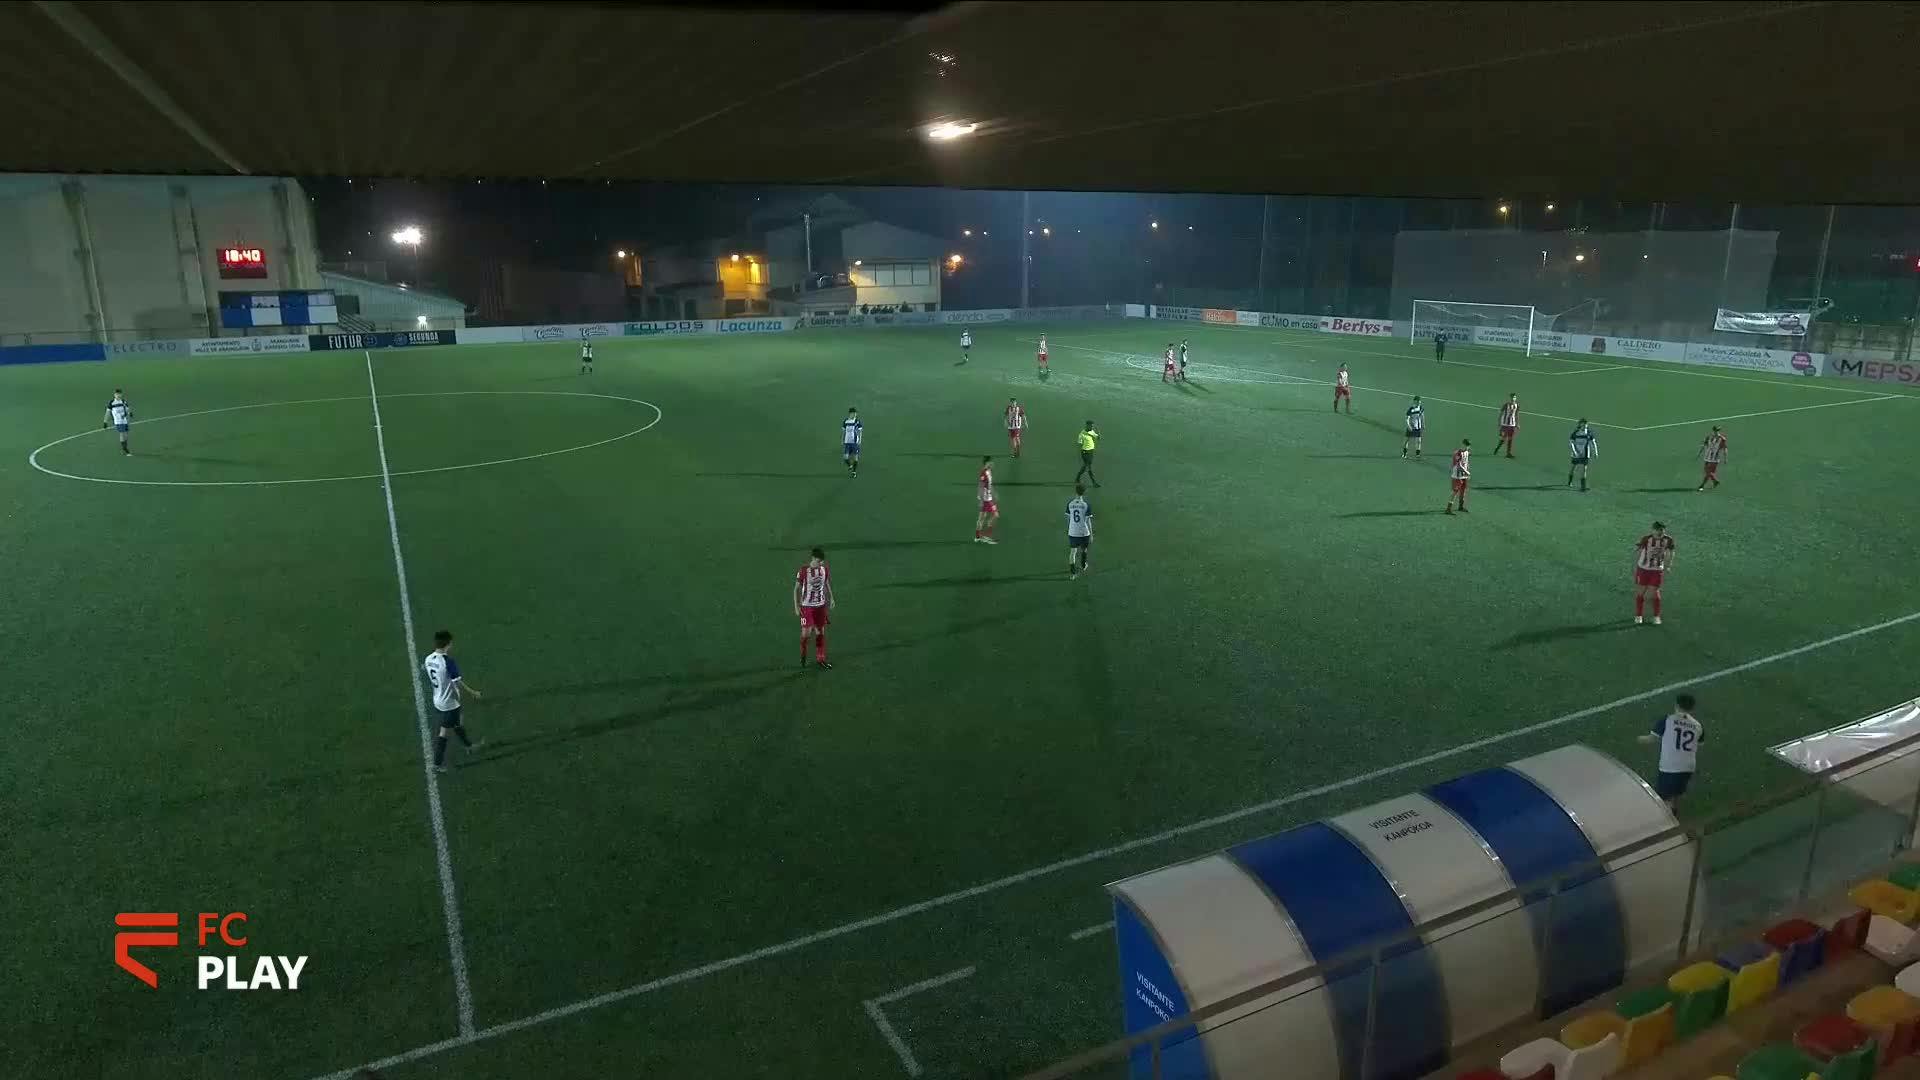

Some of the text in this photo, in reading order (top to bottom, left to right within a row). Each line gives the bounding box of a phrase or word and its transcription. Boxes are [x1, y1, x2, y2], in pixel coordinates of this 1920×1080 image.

[631, 321, 704, 331] TOLDOS
[719, 320, 782, 333] Lacunza
[1332, 318, 1381, 334] Berlys
[409, 331, 439, 341] SEGUNDA
[113, 341, 177, 353] ELECTRO
[1617, 339, 1662, 351] CALDERO
[1073, 509, 1081, 523] 6
[430, 669, 439, 689] 5
[1673, 727, 1695, 752] 12
[1368, 809, 1420, 830] VISITANTE
[1384, 821, 1434, 842] KANPOKOA
[1136, 971, 1175, 1012] VISITANTE
[1136, 987, 1172, 1022] KANPOKO
